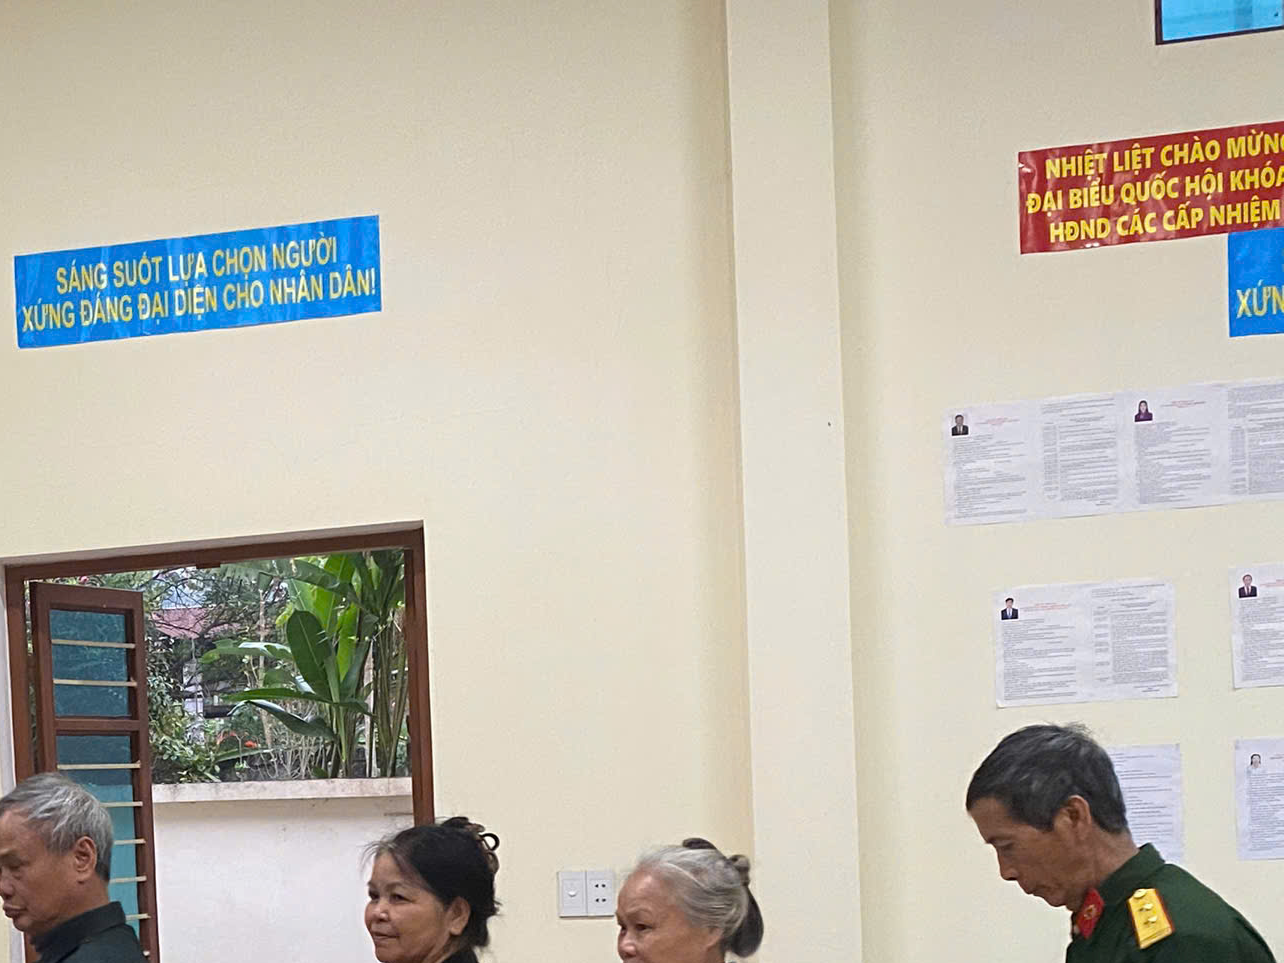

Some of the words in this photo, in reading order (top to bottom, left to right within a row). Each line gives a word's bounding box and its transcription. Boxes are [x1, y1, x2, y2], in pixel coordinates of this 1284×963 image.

[1045, 149, 1108, 181] NHIỆT
[1113, 143, 1155, 175] LIỆT
[1160, 136, 1220, 166] CHÀO
[1227, 129, 1284, 159] MỪN
[1025, 191, 1063, 217] ĐẠI
[1069, 178, 1115, 209] BIỂU
[1120, 171, 1180, 206] QUỐC
[1185, 167, 1224, 201] HỘI
[1049, 217, 1112, 243] HĐND
[1116, 208, 1157, 237] CÁC
[1162, 201, 1204, 231] CẤP
[1210, 195, 1281, 228] NHIỆM
[56, 258, 108, 294] SÁNG
[168, 251, 207, 287] LỰA
[212, 244, 266, 280] CHỌN
[272, 232, 337, 270] NGƯỜI
[22, 297, 75, 332] XỨNG
[79, 291, 133, 326] ĐÁNG
[137, 291, 169, 325] ĐẠI
[174, 284, 217, 320] DIỆN
[222, 280, 265, 311] CHO
[270, 269, 323, 305] NHÂN
[329, 263, 376, 300] DÂN!
